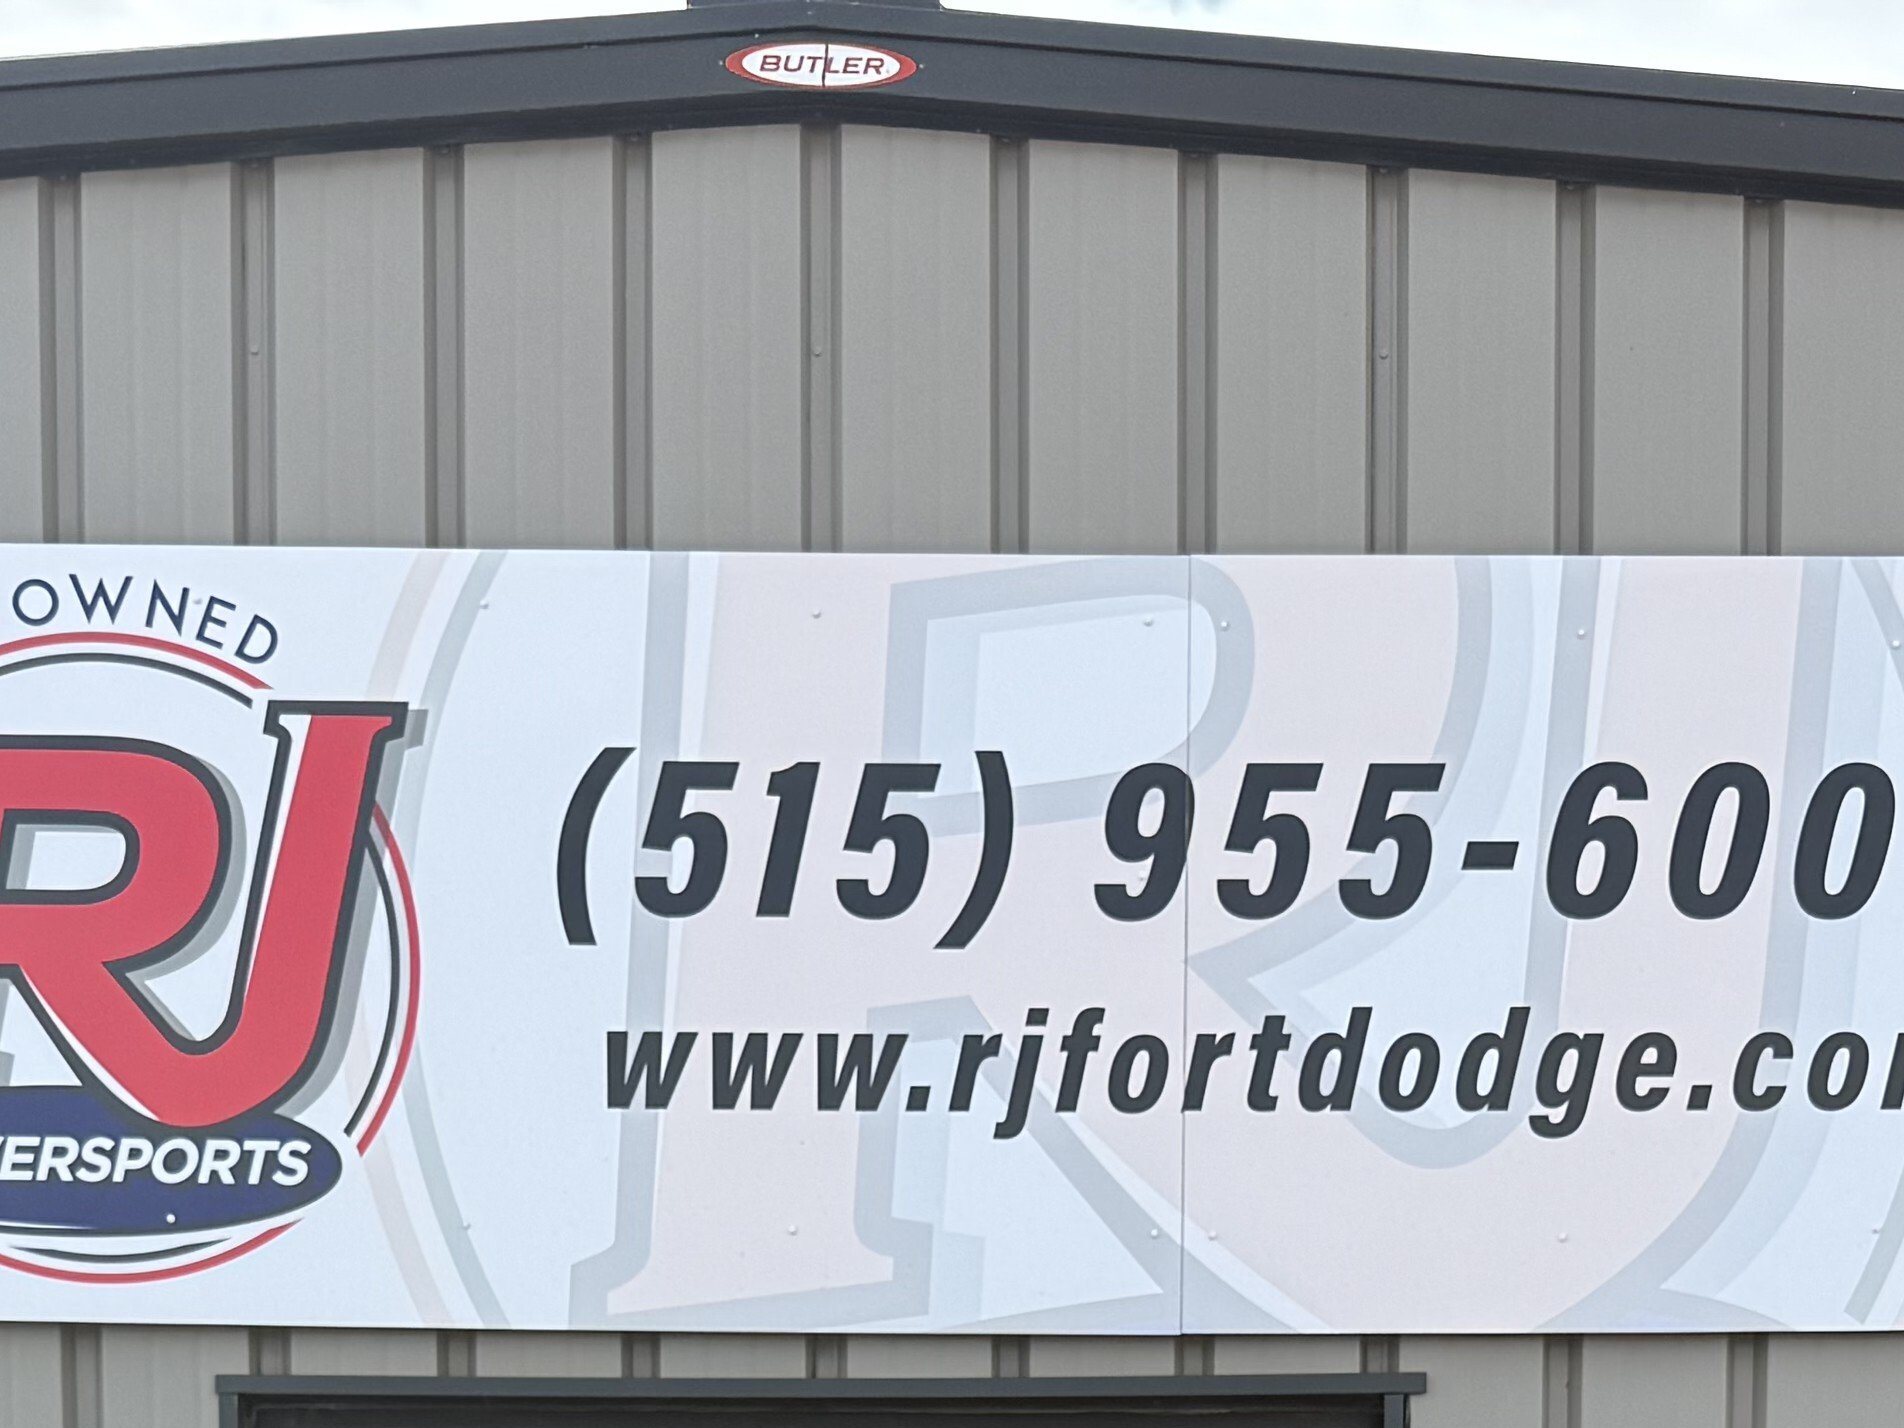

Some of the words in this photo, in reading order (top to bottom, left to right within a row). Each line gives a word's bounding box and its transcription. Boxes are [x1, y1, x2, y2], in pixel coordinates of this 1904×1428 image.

[759, 54, 885, 75] BUTLER
[12, 574, 279, 664] OWNED
[556, 747, 1015, 950] (515)
